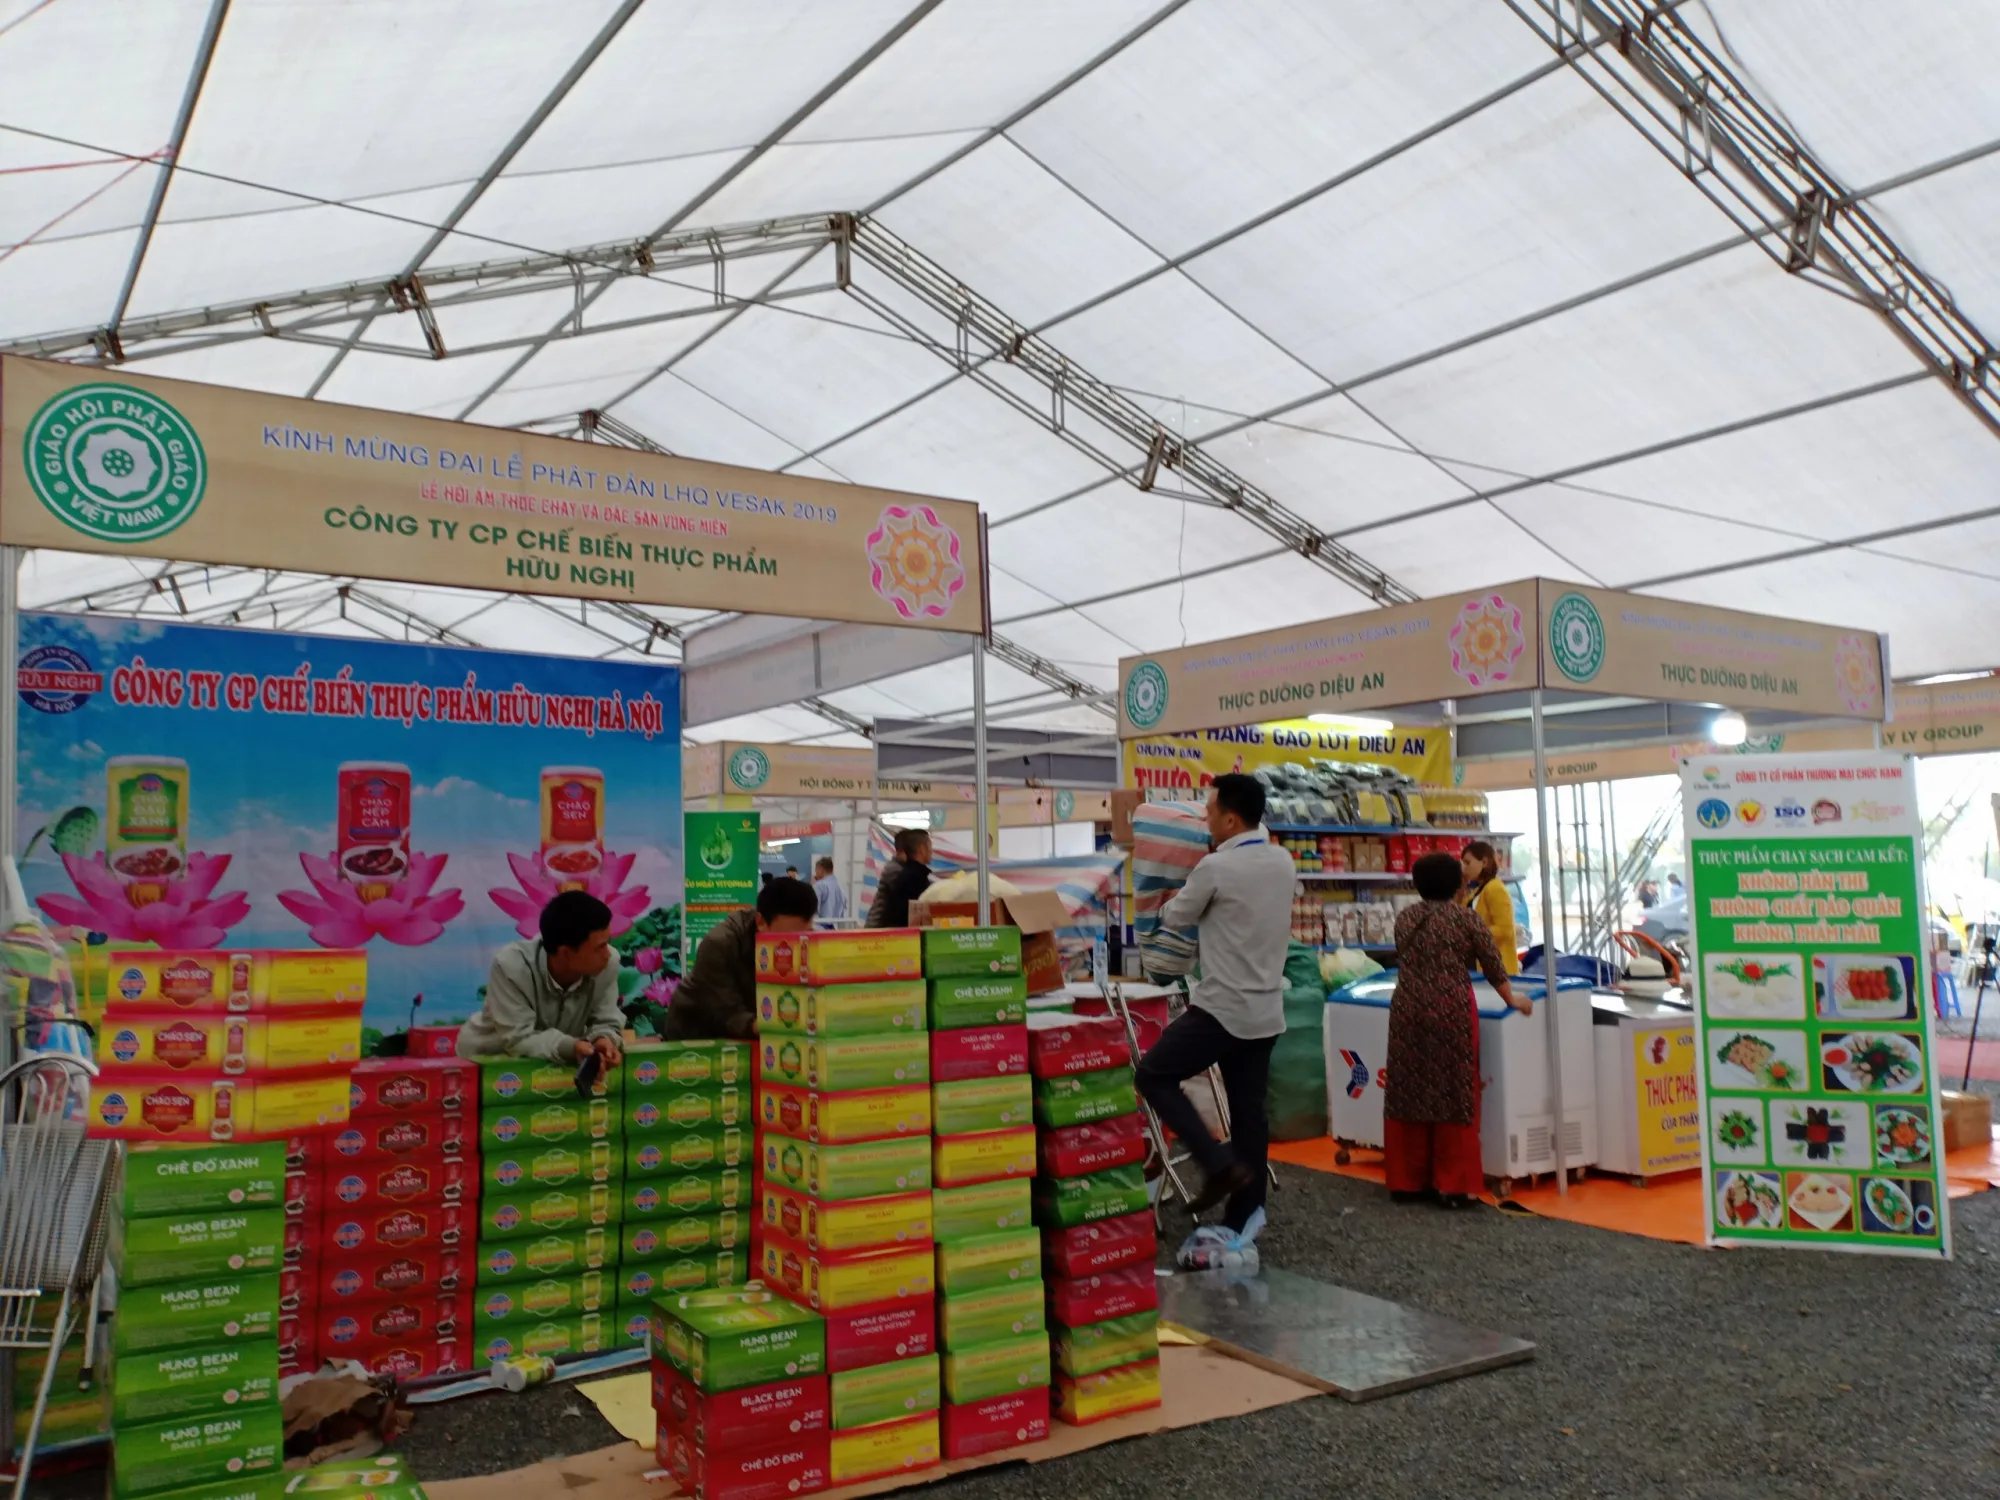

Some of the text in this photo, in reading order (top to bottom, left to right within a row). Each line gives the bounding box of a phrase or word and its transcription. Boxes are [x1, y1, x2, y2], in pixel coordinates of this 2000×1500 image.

[41, 398, 193, 490] GIÁO HỘI PHẬT GIÁO
[345, 435, 430, 467] MỪNG
[439, 449, 483, 477] ĐẠI
[492, 452, 523, 480] LỄ
[532, 463, 598, 493] PHẬT
[663, 483, 709, 508] LHQ
[716, 489, 786, 517] VESAK
[792, 502, 838, 524] 2019
[70, 493, 164, 527] VIỆT NAM
[323, 504, 778, 577] CÔNG TY CP CHẾ BIẾN THỰC PHẨM
[506, 554, 635, 595] HỮU NGHỊ
[1660, 662, 1697, 688] THỰC
[1750, 670, 1778, 696] DIỆU
[1781, 677, 1798, 695] AN
[112, 655, 184, 708] CÔNG
[187, 670, 223, 709] TY
[225, 672, 258, 711] CP
[261, 661, 310, 713] CHẾ
[311, 665, 368, 718] BIẾN
[370, 680, 432, 729] THỰC
[435, 670, 494, 724] PHẨM
[497, 682, 541, 727] HỮU
[545, 692, 595, 738] NGHỊ
[597, 689, 627, 731] HÀ
[628, 691, 664, 742] NỘI
[1218, 671, 1385, 713] THỰC DƯỠNG DIỆU AN
[1901, 729, 1918, 744] LY
[1923, 724, 1984, 741] GROUP
[1402, 738, 1425, 757] AN
[1557, 760, 1598, 776] GROUP
[866, 780, 889, 791] TNH
[1774, 806, 1806, 819] ISO
[1698, 847, 1732, 868] THỰC
[1734, 844, 1770, 866] PHẨM
[1772, 849, 1807, 864] CHAY
[1809, 849, 1844, 867] SẠCH
[1846, 847, 1876, 863] CAM
[1738, 868, 1798, 892] KHÔNG
[1838, 871, 1869, 892] THE
[1710, 894, 1770, 918] KHÔNG
[1771, 892, 1815, 918] CHẤT
[951, 932, 999, 942] MUNG BEAN
[1733, 919, 1794, 944] KHÔNG
[954, 986, 974, 999] CHÈ
[990, 985, 1013, 996] XANH
[156, 1159, 190, 1176] CHÈ
[219, 1156, 260, 1171] XANH
[169, 1217, 248, 1236] MUNG BEAN
[160, 1284, 241, 1304] MUNG BEAN
[740, 1329, 798, 1348] MUNG BEAN
[158, 1351, 239, 1373] MUNG BEAN
[741, 1386, 802, 1407] BLACK BEAN
[160, 1419, 242, 1442] MUNG BEAN
[741, 1457, 763, 1473] CHÈ
[782, 1450, 803, 1464] ĐEN
